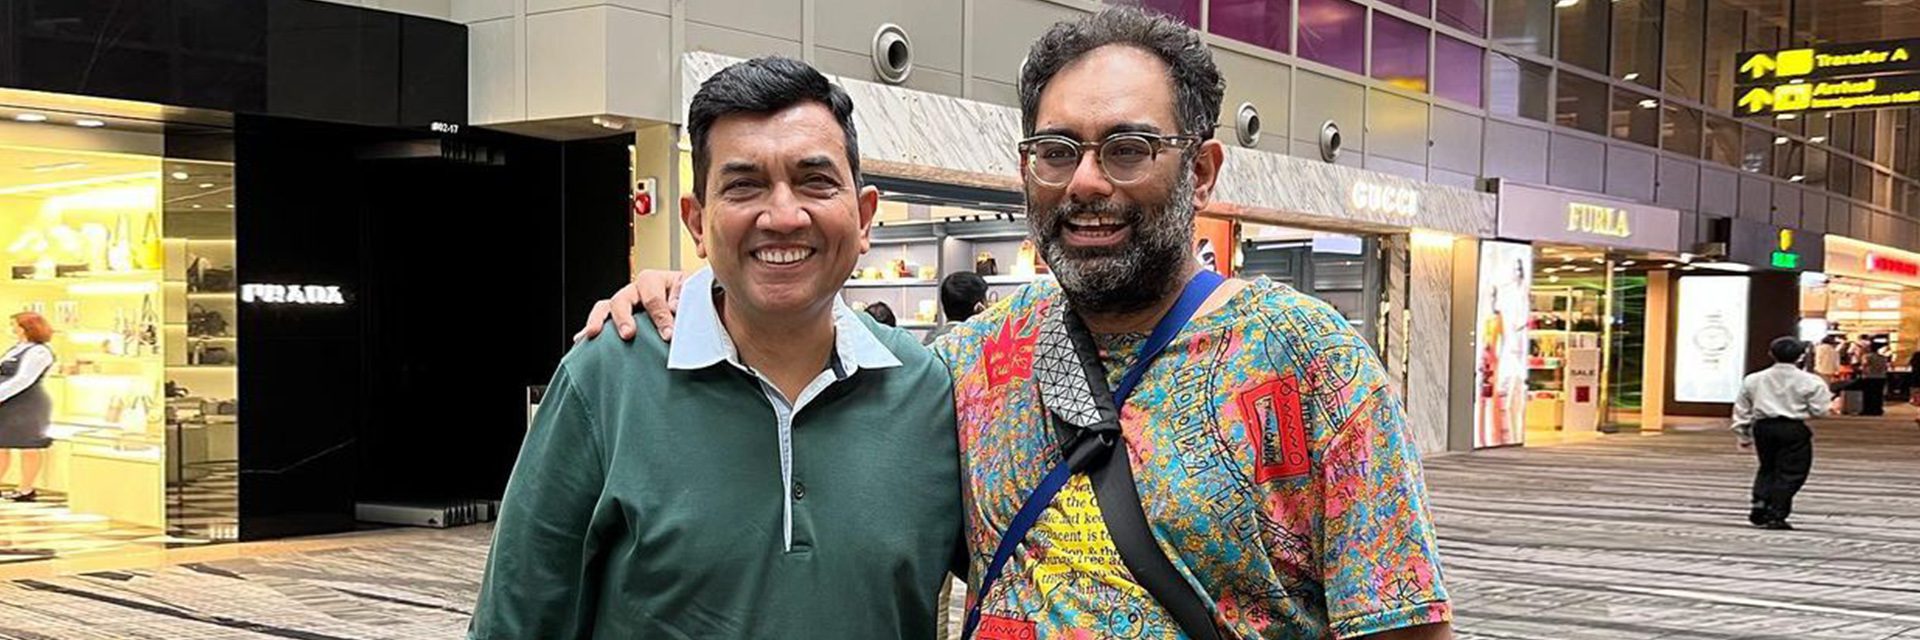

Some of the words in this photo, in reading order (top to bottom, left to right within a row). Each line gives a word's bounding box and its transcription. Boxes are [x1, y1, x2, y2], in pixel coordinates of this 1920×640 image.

[1816, 50, 1889, 67] Transfer
[1890, 48, 1908, 61] A
[1813, 79, 1876, 95] Arrival
[1352, 182, 1417, 217] GUCCI
[1567, 202, 1631, 238] FURLA
[242, 283, 345, 304] PRADA
[1066, 496, 1086, 507] the
